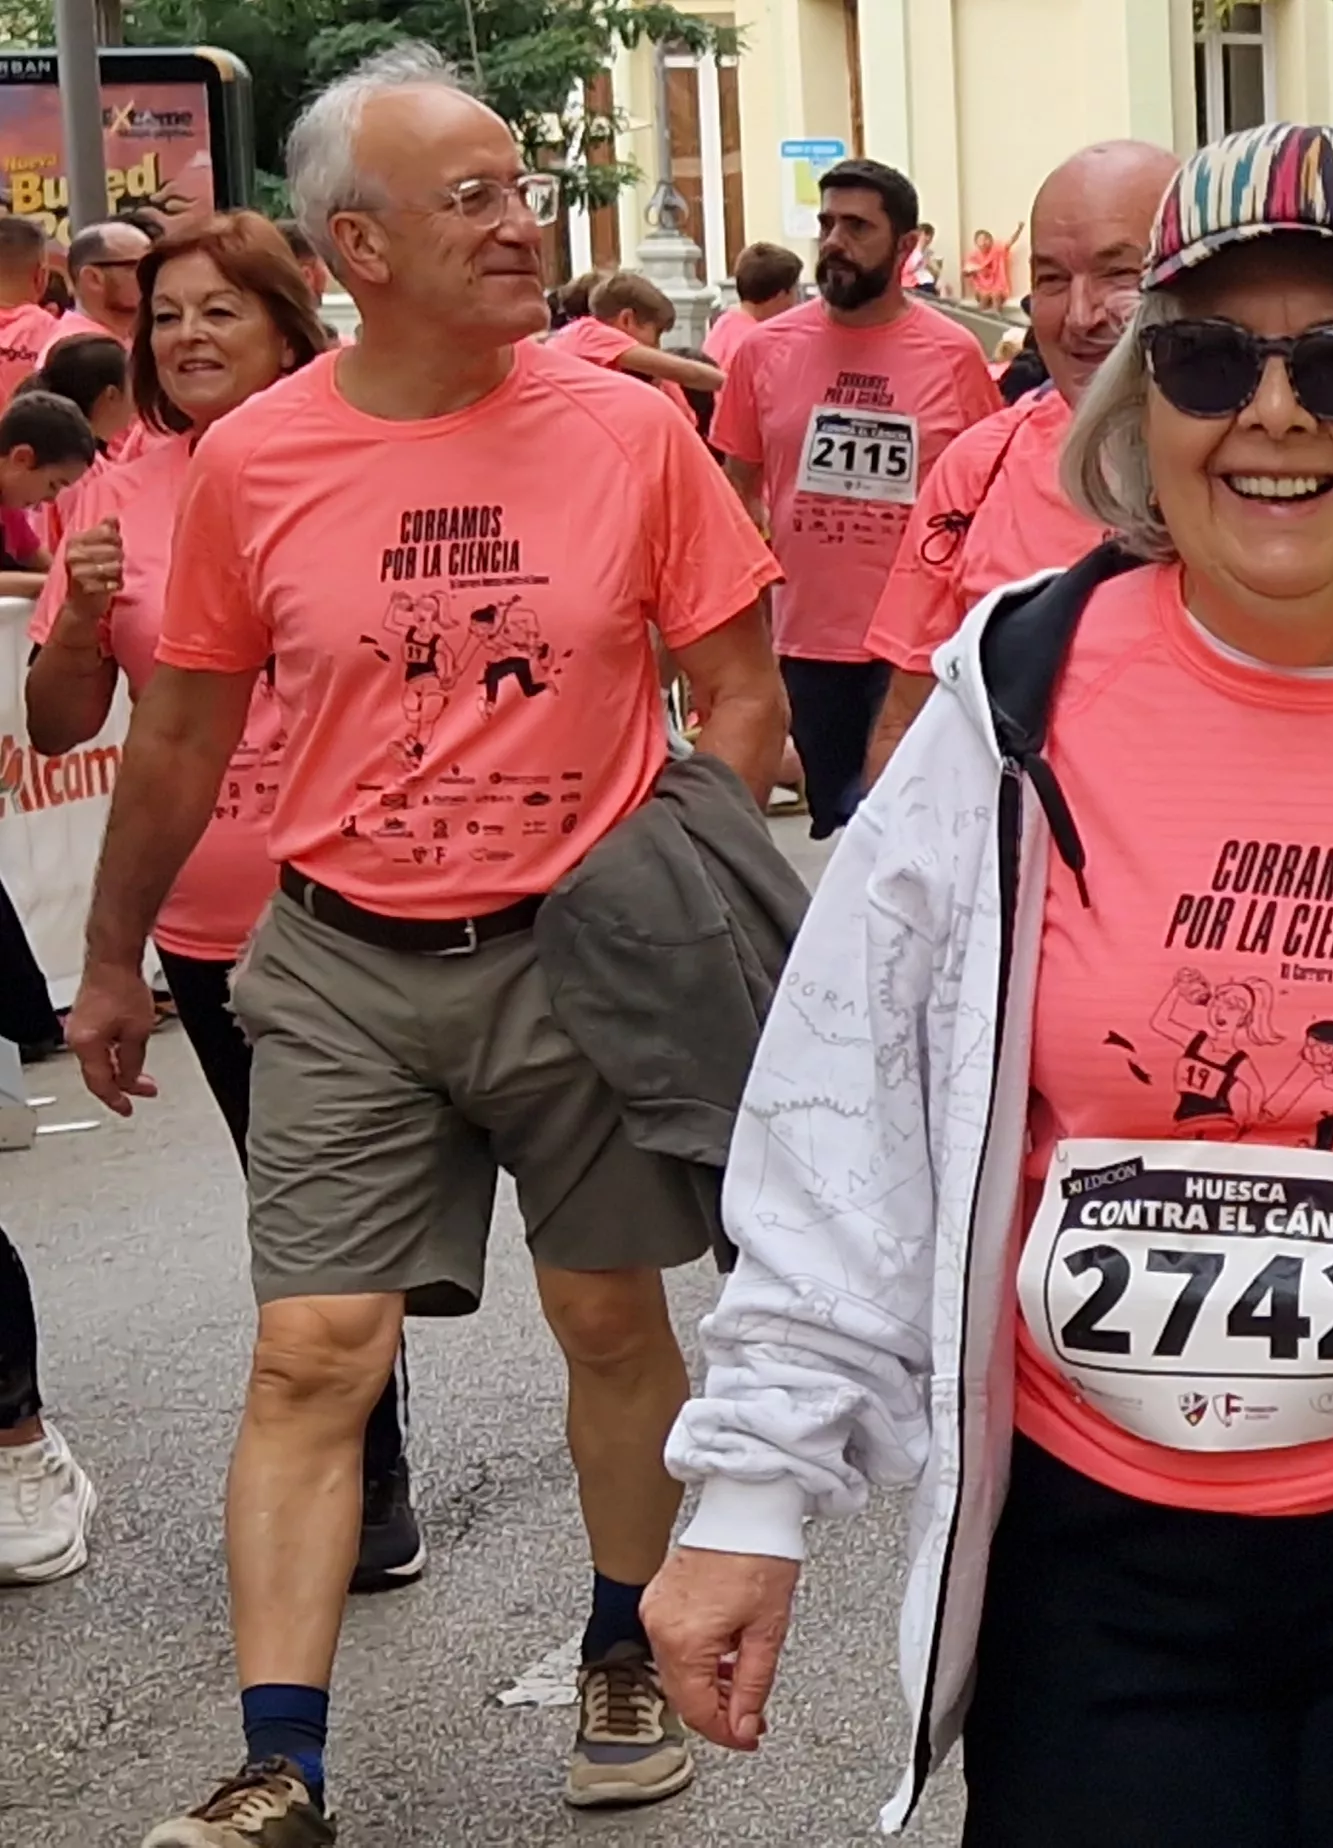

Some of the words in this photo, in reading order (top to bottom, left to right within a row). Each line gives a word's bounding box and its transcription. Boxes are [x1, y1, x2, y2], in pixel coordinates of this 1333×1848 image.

[812, 437, 907, 477] 2115
[400, 506, 503, 544] CORRAMOS
[379, 547, 417, 583] POR
[422, 544, 442, 579] LA
[448, 539, 520, 576] CIENCIA
[1164, 893, 1236, 951] POR
[1236, 898, 1278, 955] LA
[1068, 1179, 1082, 1196] XI
[1185, 1176, 1287, 1204] HUESCA
[1080, 1199, 1209, 1231] CONTRA
[1218, 1205, 1257, 1233] EL
